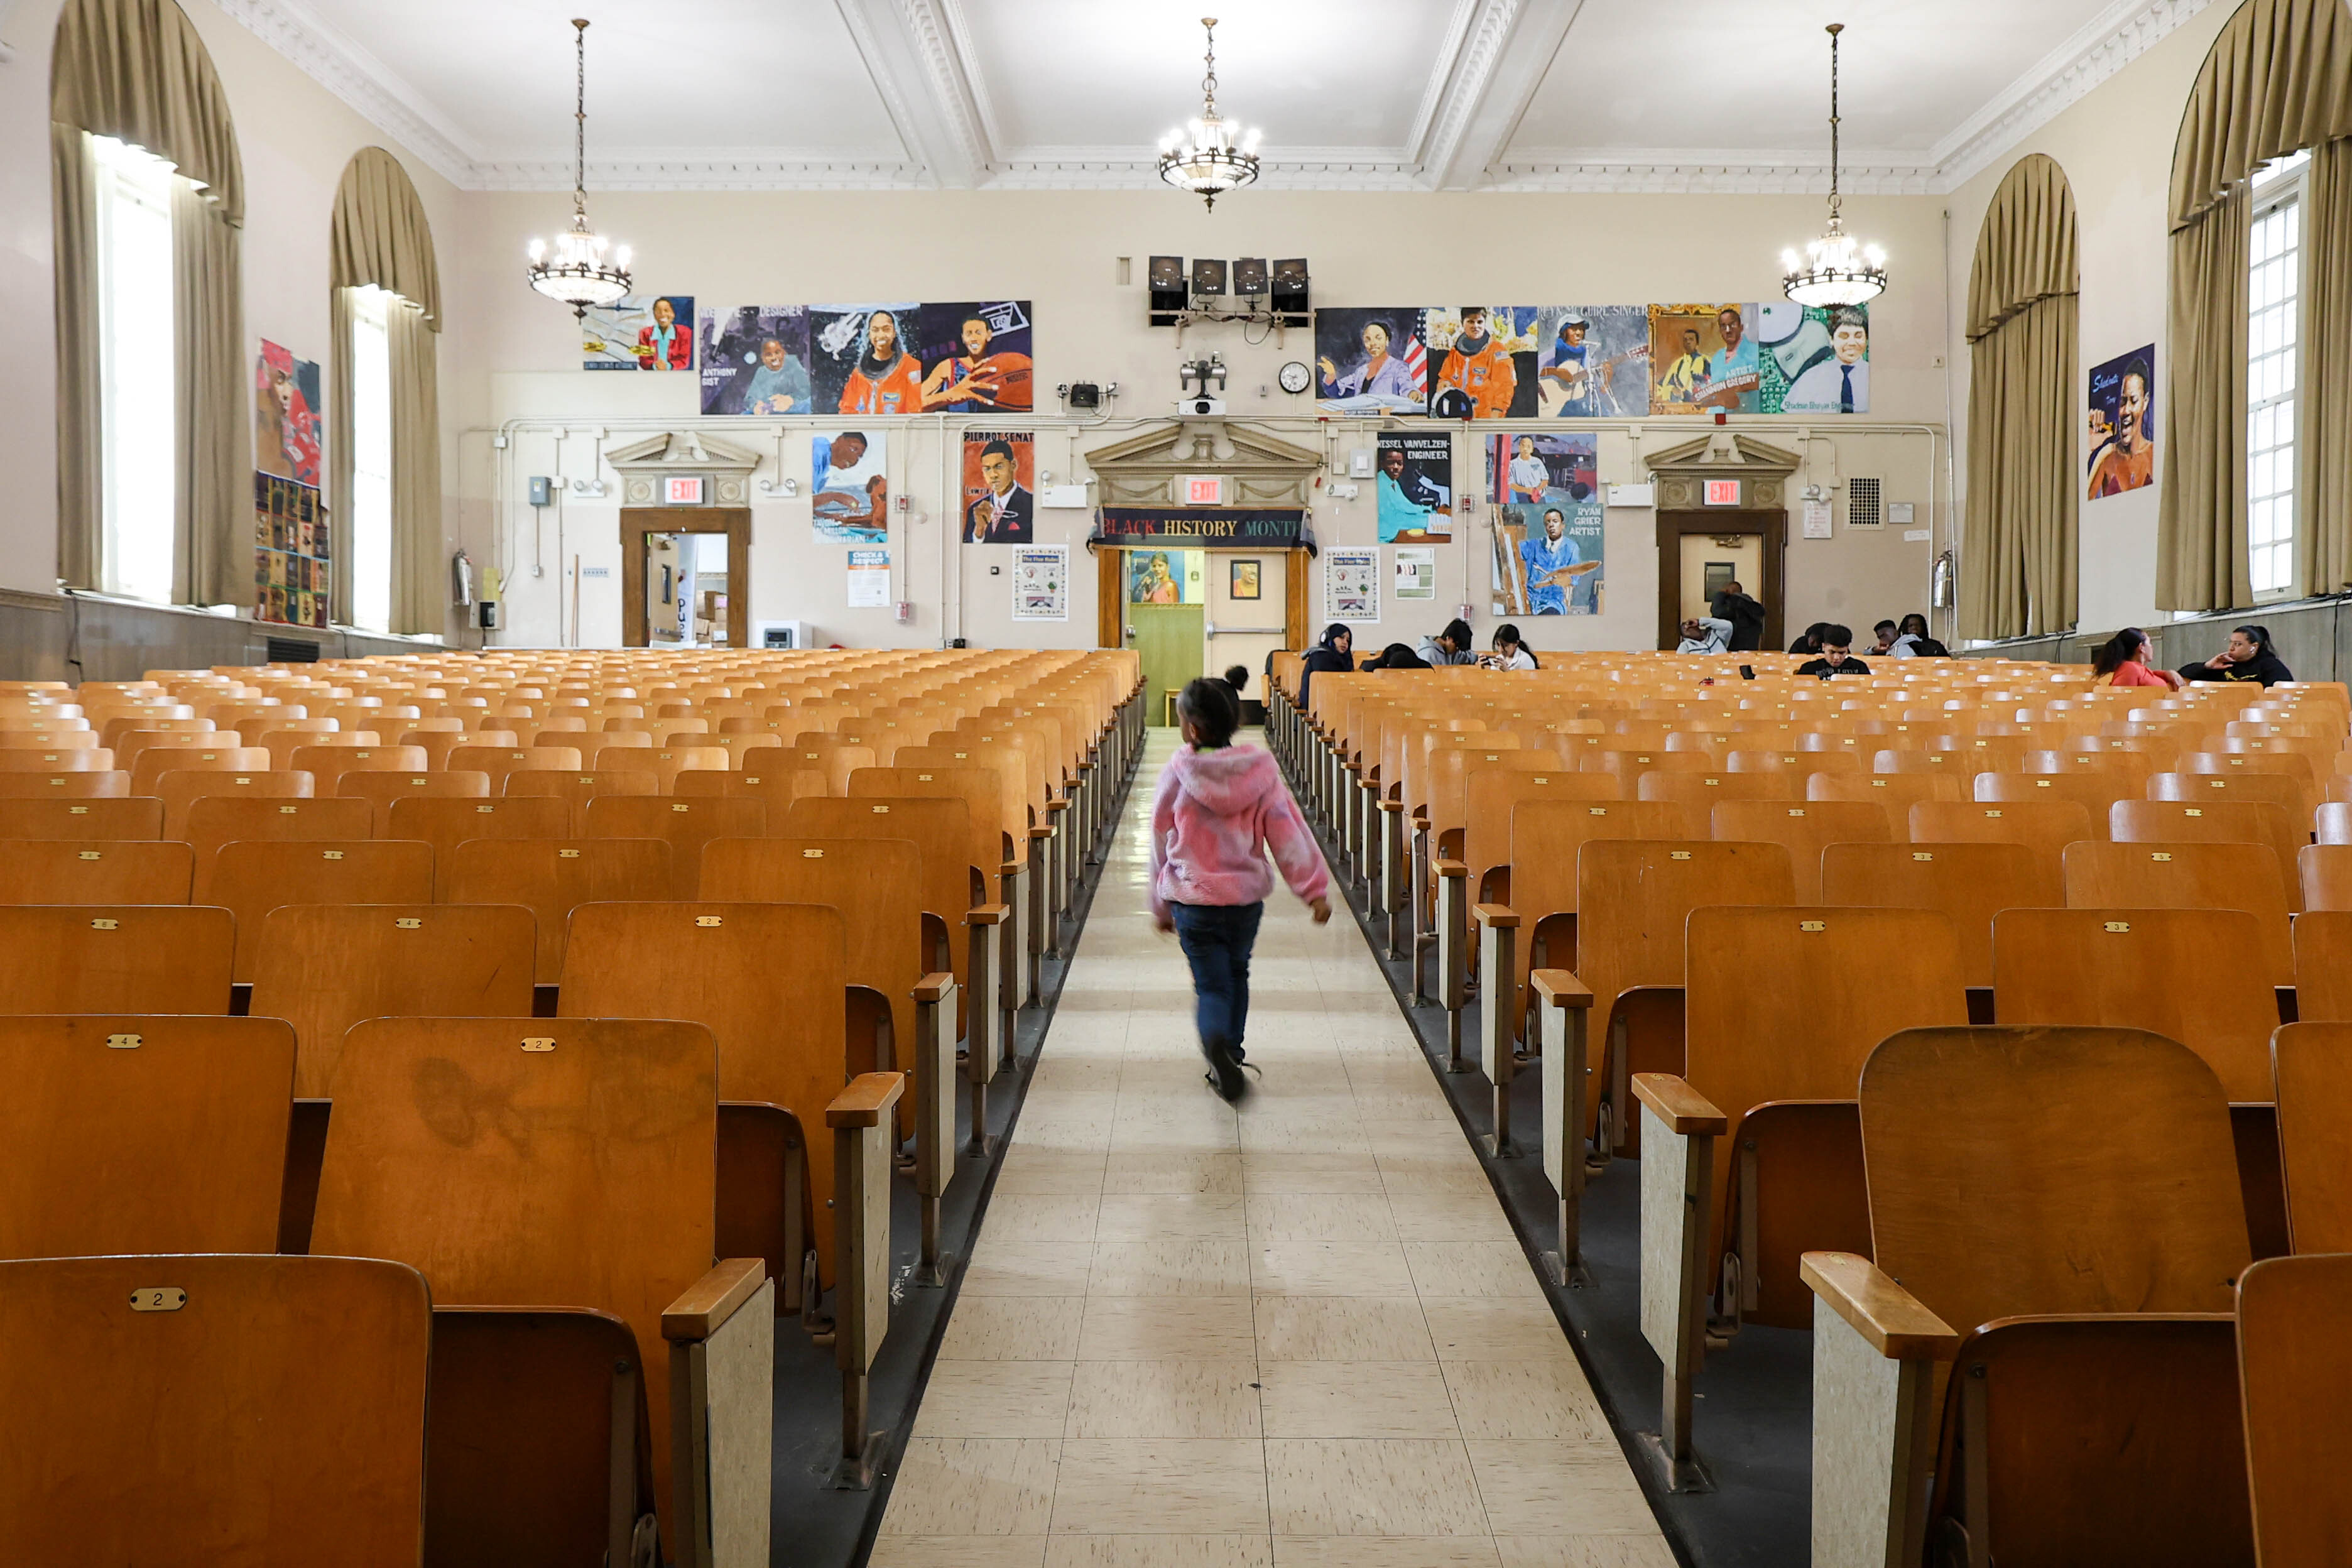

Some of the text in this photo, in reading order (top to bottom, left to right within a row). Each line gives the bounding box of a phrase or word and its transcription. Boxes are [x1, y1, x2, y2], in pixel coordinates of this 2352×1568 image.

[964, 432, 1001, 442] PIERROT
[1407, 450, 1448, 460] ENGINEER
[672, 480, 699, 500] EXIT
[1190, 480, 1219, 501] EXIT
[1710, 481, 1738, 503] EXIT
[1577, 508, 1601, 516] RYAN
[1574, 516, 1601, 525] GRIER
[1104, 518, 1156, 535] BLACK
[1164, 520, 1238, 536] HISTORY
[1569, 526, 1601, 536] ARTIST
[153, 1293, 162, 1306] 2
